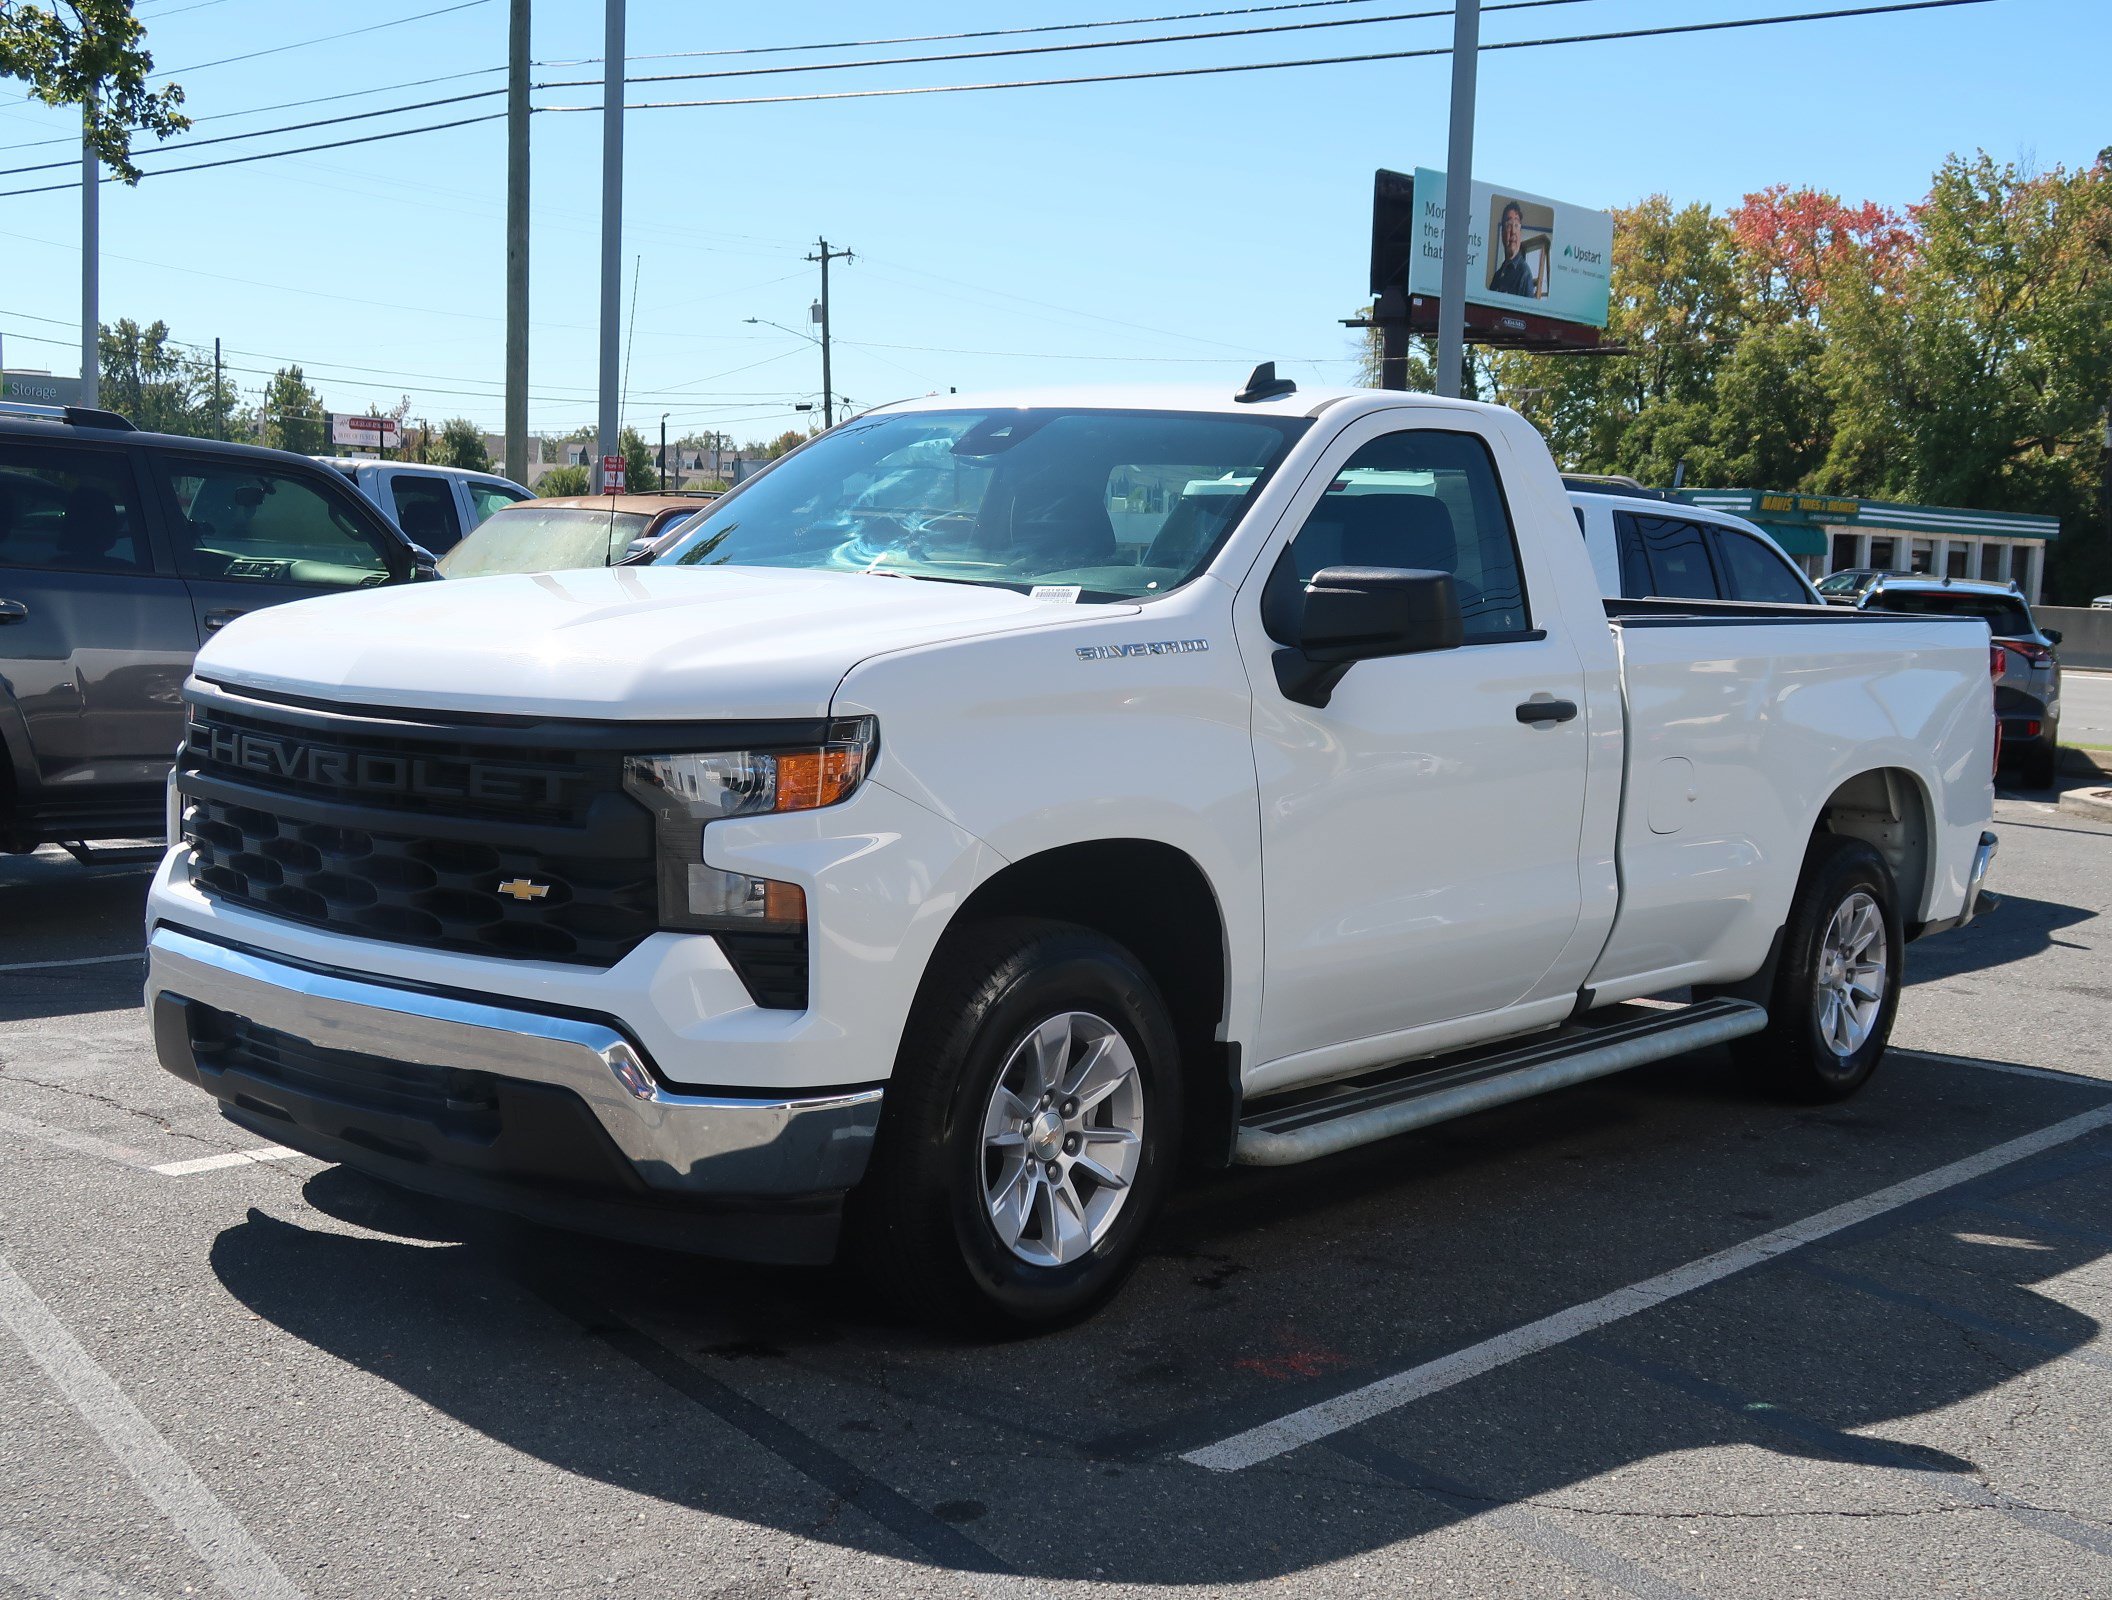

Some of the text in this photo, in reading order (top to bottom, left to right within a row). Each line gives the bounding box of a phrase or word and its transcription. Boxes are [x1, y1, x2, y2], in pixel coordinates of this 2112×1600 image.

[1424, 222, 1439, 238] the
[1423, 241, 1443, 260] that
[1574, 246, 1602, 264] Upstart
[11, 382, 57, 400] Storage
[1075, 639, 1209, 661] SILVERADO
[186, 721, 585, 801] CHEVROLET
